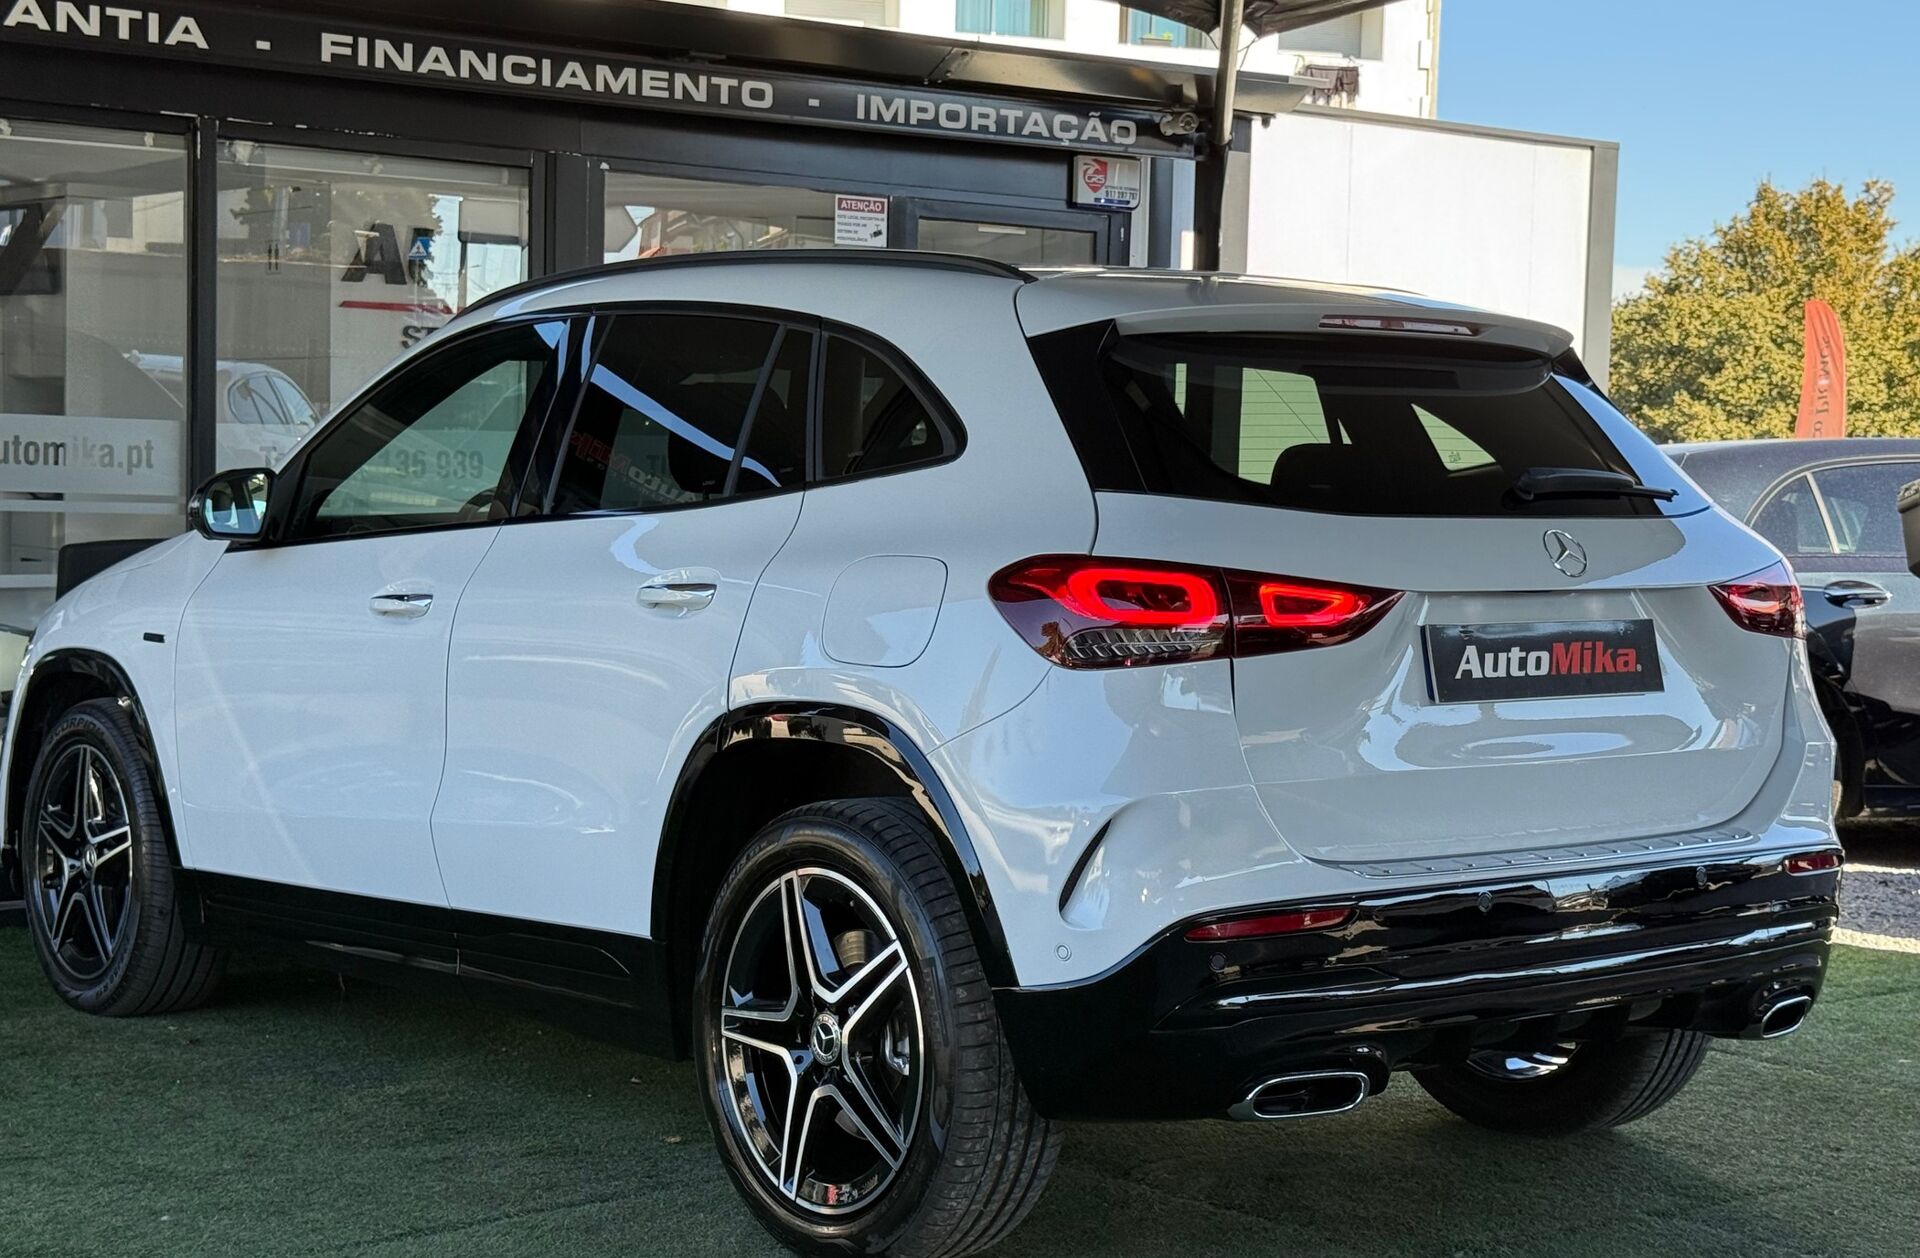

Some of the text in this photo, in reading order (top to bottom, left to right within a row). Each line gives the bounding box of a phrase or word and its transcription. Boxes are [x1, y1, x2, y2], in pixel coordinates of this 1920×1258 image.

[3, 0, 209, 49] ANTIA
[321, 32, 774, 109] FINANCIAMENTO
[856, 94, 1137, 145] IMPORTAÇÃO
[840, 199, 882, 212] ATENÇÃO
[436, 450, 484, 480] 939
